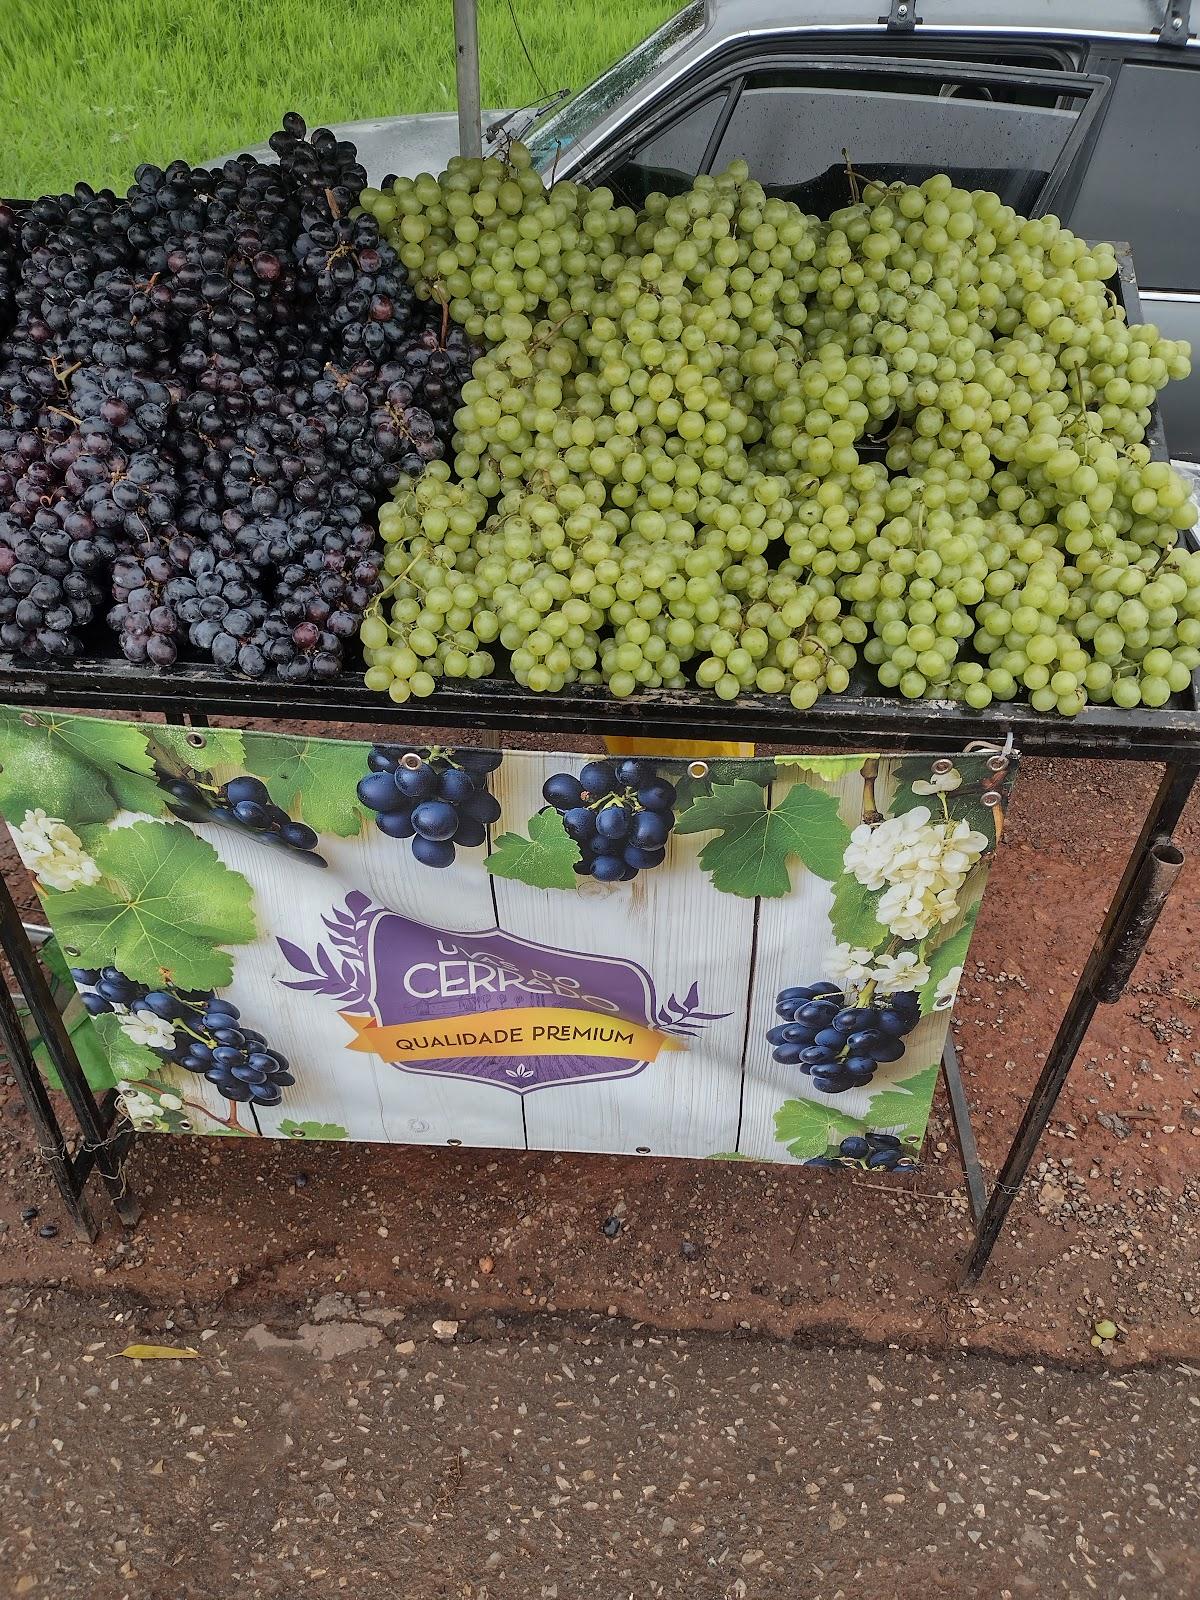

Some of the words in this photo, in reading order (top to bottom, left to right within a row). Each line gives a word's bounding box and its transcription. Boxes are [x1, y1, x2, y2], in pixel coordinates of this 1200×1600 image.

[403, 960, 620, 1012] CERRADO
[436, 939, 519, 972] UVAS
[530, 969, 581, 989] DO
[396, 1028, 524, 1051] QUALIDADE
[532, 1025, 634, 1045] PREMIUM
